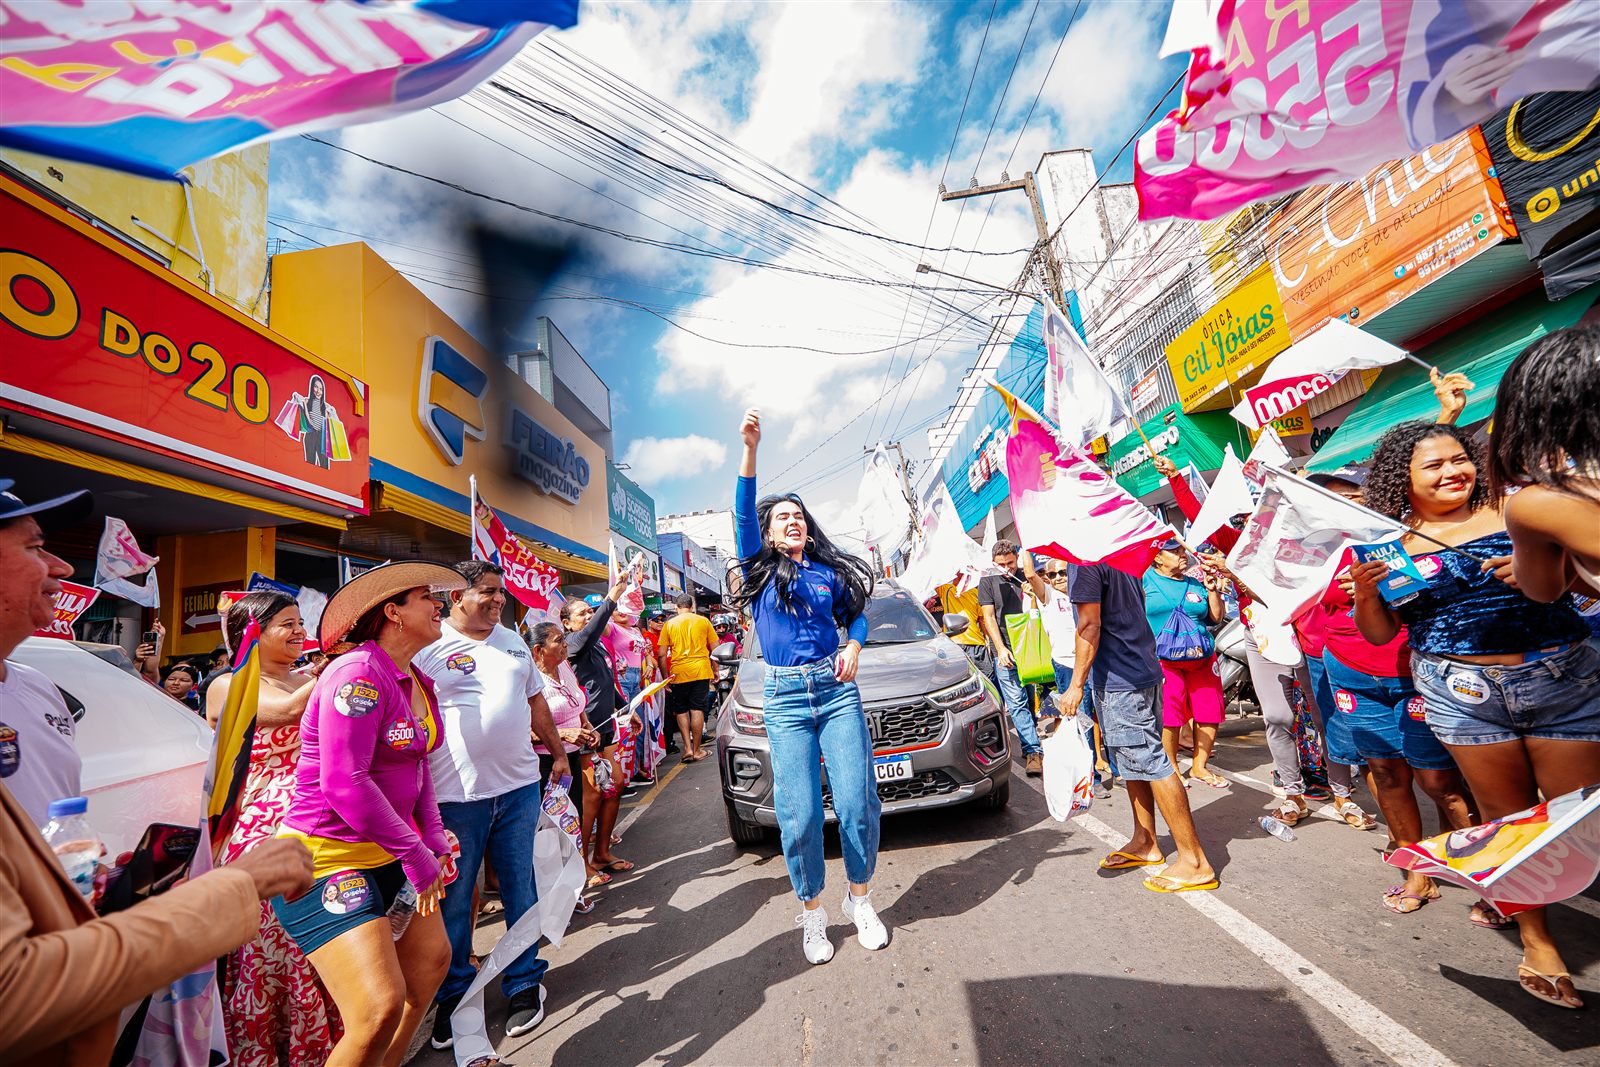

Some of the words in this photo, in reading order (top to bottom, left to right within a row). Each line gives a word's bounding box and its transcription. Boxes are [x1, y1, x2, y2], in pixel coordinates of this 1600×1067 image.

[1373, 226, 1390, 246] de
[1183, 341, 1212, 382] Gil
[1212, 304, 1274, 368] Jóias
[99, 306, 183, 376] DO
[184, 341, 271, 425] 20
[511, 409, 591, 487] FEIRÃO
[519, 453, 580, 501] magazine
[626, 496, 651, 524] SORRISO
[634, 517, 653, 540] TODOS
[1364, 543, 1398, 562] PAULA
[50, 591, 87, 613] AULA
[184, 590, 216, 613] FEIRÃO
[356, 687, 378, 698] 1523
[388, 727, 414, 741] 55000
[342, 878, 364, 890] 1523
